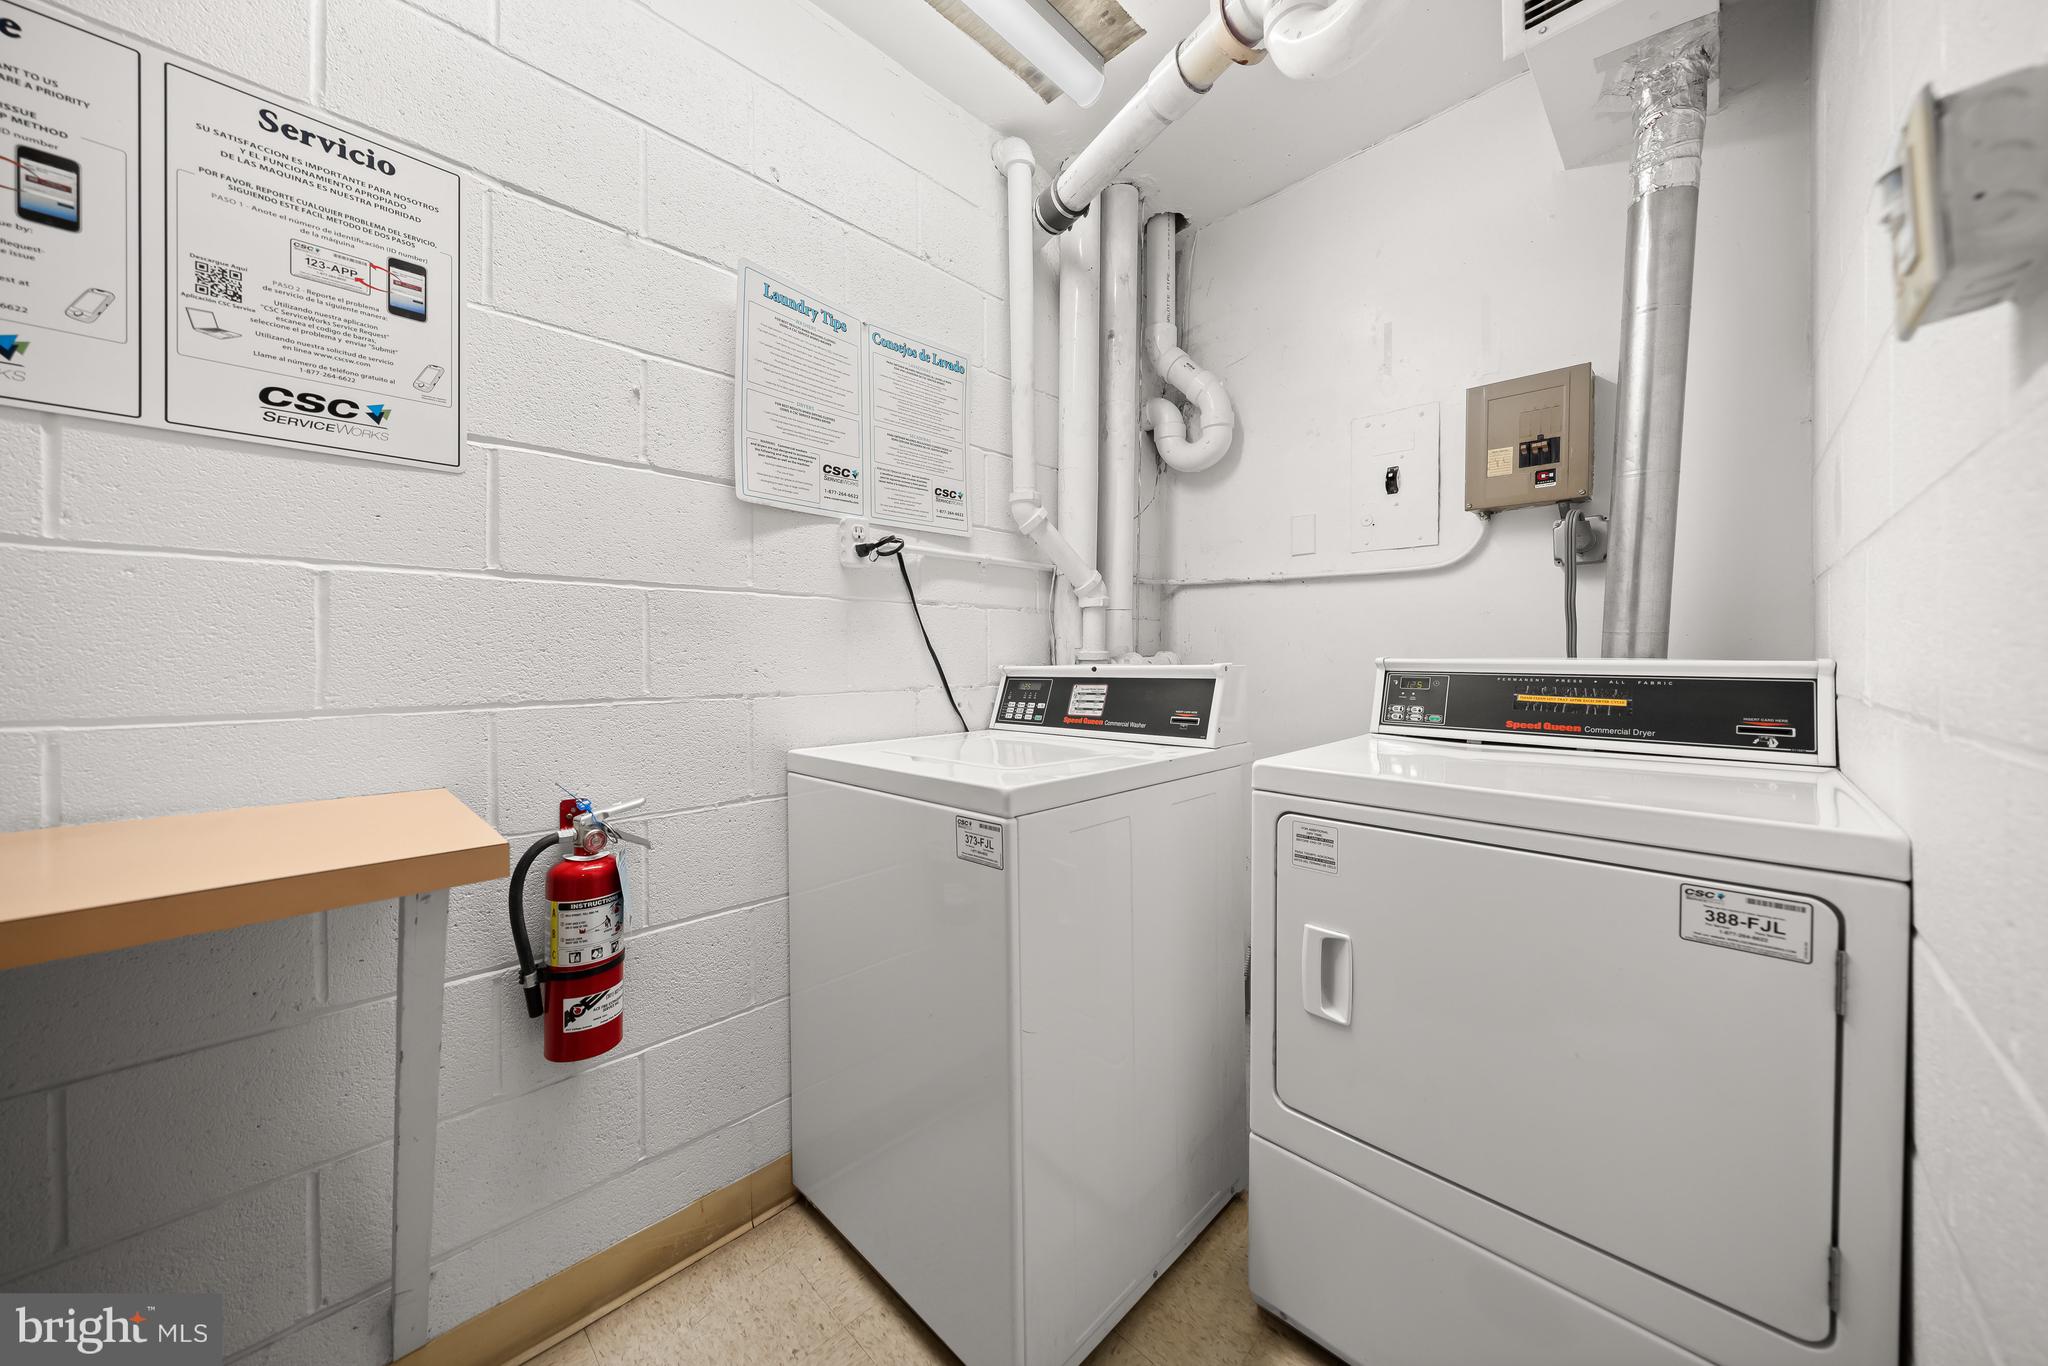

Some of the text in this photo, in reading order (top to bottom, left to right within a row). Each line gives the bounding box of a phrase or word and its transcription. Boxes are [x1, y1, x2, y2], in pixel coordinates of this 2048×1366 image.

[23, 69, 58, 88] TO US
[24, 81, 32, 90] A
[36, 85, 89, 109] PRIORITY
[11, 115, 68, 139] METHOD
[258, 106, 395, 177] Servicio
[195, 122, 439, 213] SU SATISFACCION ES IMPORTANTE PARA NOSOTROS
[240, 147, 406, 210] Y EL FUNCIONAMIENTO APROPIADO
[220, 150, 421, 223] DE LAS MAQUINAS ES NUESTRA PRIORIDAD
[199, 166, 218, 178] POR
[256, 184, 294, 203] REPORTE
[296, 197, 342, 218] CUALQUIER
[344, 213, 385, 232] PROBLEMA
[387, 227, 400, 236] DEL
[211, 192, 235, 205] PASO
[251, 204, 277, 218] Anote
[322, 226, 331, 234] de
[228, 184, 415, 248] SIGUIENDO ESTE FACIL METODO DE DOS PASOS
[9, 249, 35, 261] issue
[305, 256, 357, 279] 123-APP
[272, 280, 293, 290] PASO
[306, 289, 335, 301] Reporte
[345, 299, 379, 313] problema
[274, 288, 303, 300] servicio
[325, 301, 358, 314] siguiente
[763, 282, 819, 323] Laundry
[821, 308, 847, 333] Tips
[273, 300, 312, 314] Utilizando
[314, 310, 341, 321] nuestra
[275, 315, 309, 328] escanea
[255, 330, 294, 344] Utilizando
[296, 340, 324, 351] nuestra
[326, 346, 356, 357] solicitud
[368, 355, 393, 366] servicio
[872, 332, 917, 358] Consejos
[919, 349, 930, 363] de
[932, 352, 965, 375] Lavado
[253, 350, 276, 360] Llame
[360, 373, 387, 383] gratuito
[299, 367, 355, 383] 1-877-264-6622
[258, 382, 359, 422] CSC
[822, 463, 850, 478] CSC
[934, 487, 956, 498] CSC
[1063, 716, 1147, 729] Speed Queen Commercial Washer
[1505, 720, 1655, 738] Speed Queen Commercial Dryer
[965, 834, 994, 850] 373-FJL
[1685, 888, 1715, 899] CSC
[1705, 909, 1786, 935] 388-FJL
